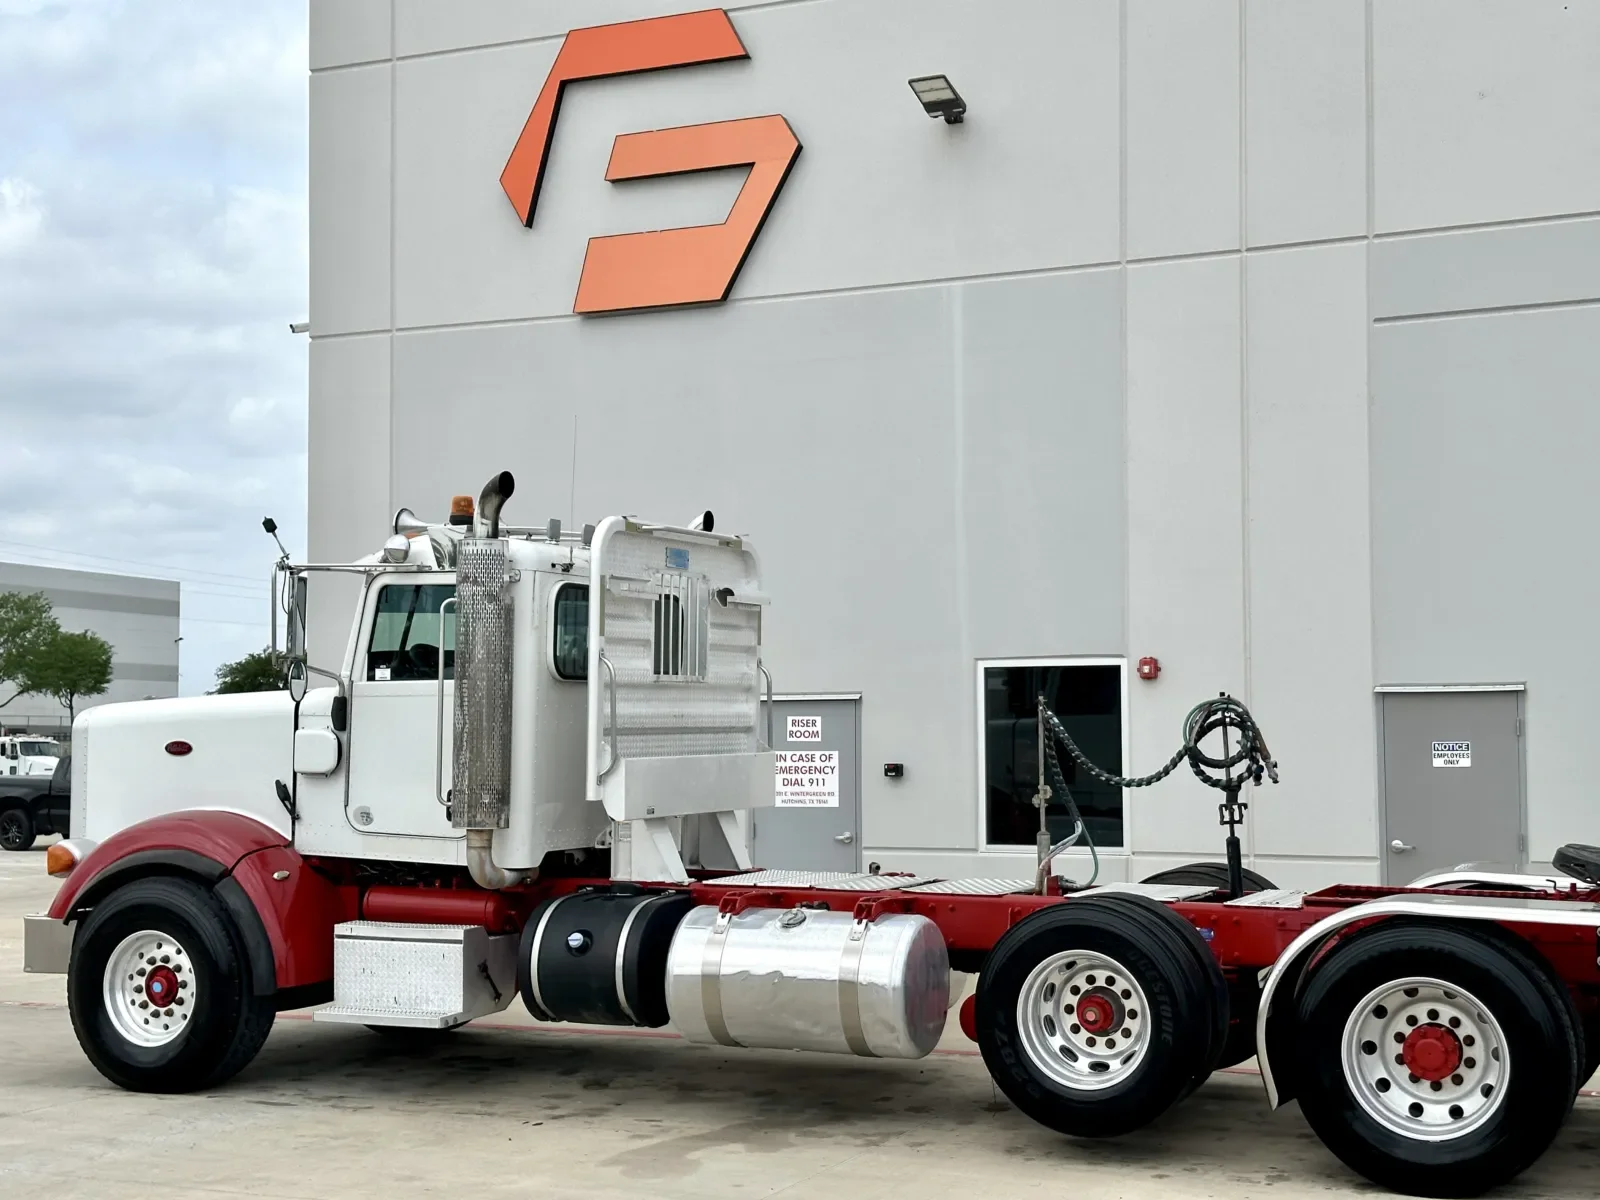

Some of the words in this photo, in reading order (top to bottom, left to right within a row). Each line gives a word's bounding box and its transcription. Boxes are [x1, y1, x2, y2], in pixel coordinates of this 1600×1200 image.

[791, 719, 817, 728] RISER
[788, 730, 820, 738] ROOM
[1434, 743, 1468, 751] NOTICE
[775, 753, 787, 762] IN
[790, 753, 816, 762] CASE
[819, 753, 833, 762] OF
[775, 765, 836, 775] EMERGENCY
[782, 778, 805, 787] DIAL
[808, 778, 826, 787] 911
